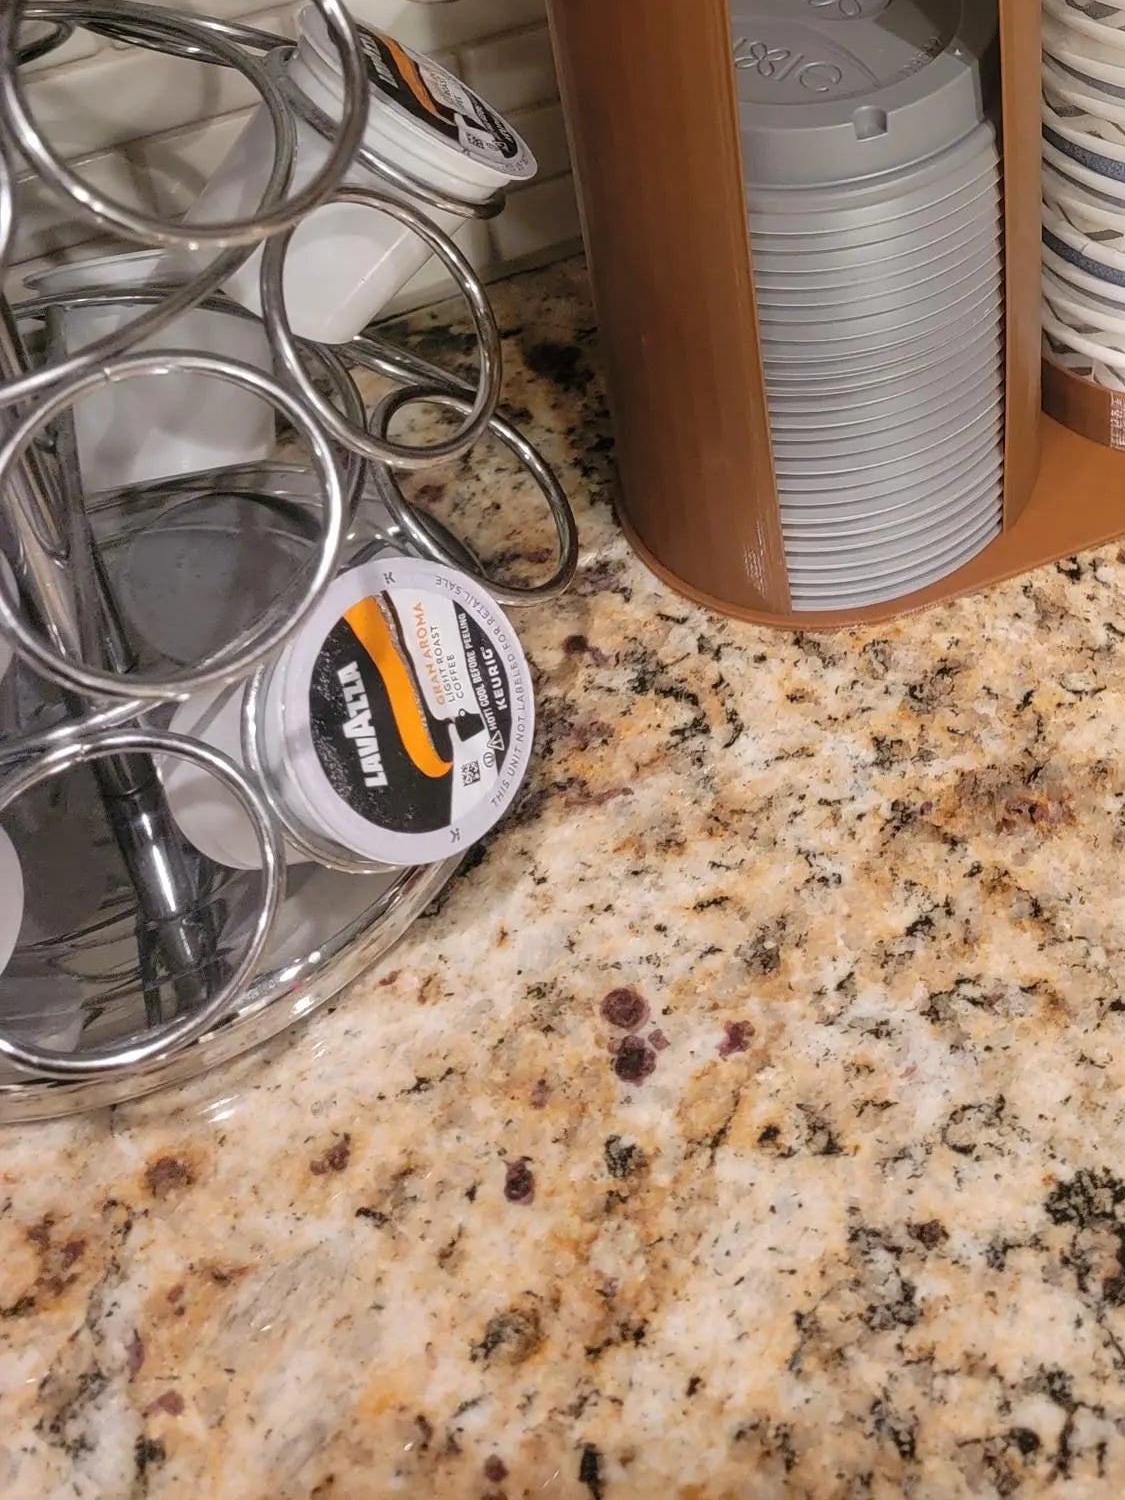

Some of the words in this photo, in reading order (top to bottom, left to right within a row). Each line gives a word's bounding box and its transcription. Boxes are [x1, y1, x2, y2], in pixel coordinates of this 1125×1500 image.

[435, 575, 463, 595] SALE
[464, 591, 496, 626] RETAIL
[413, 601, 433, 659] AROMA
[430, 625, 445, 665] ROAST
[458, 612, 473, 649] PEELING
[493, 627, 511, 651] FOR
[425, 663, 446, 706] GRAN
[439, 667, 456, 703] LIGHT
[446, 654, 464, 699] COFFEE
[466, 650, 483, 686] BEFORE
[507, 653, 526, 710] LABELED
[475, 686, 490, 707] COOL
[337, 660, 389, 787] LAVAZZA
[515, 716, 526, 743] NOT
[507, 747, 523, 777] UNIT
[491, 779, 511, 807] THIS
